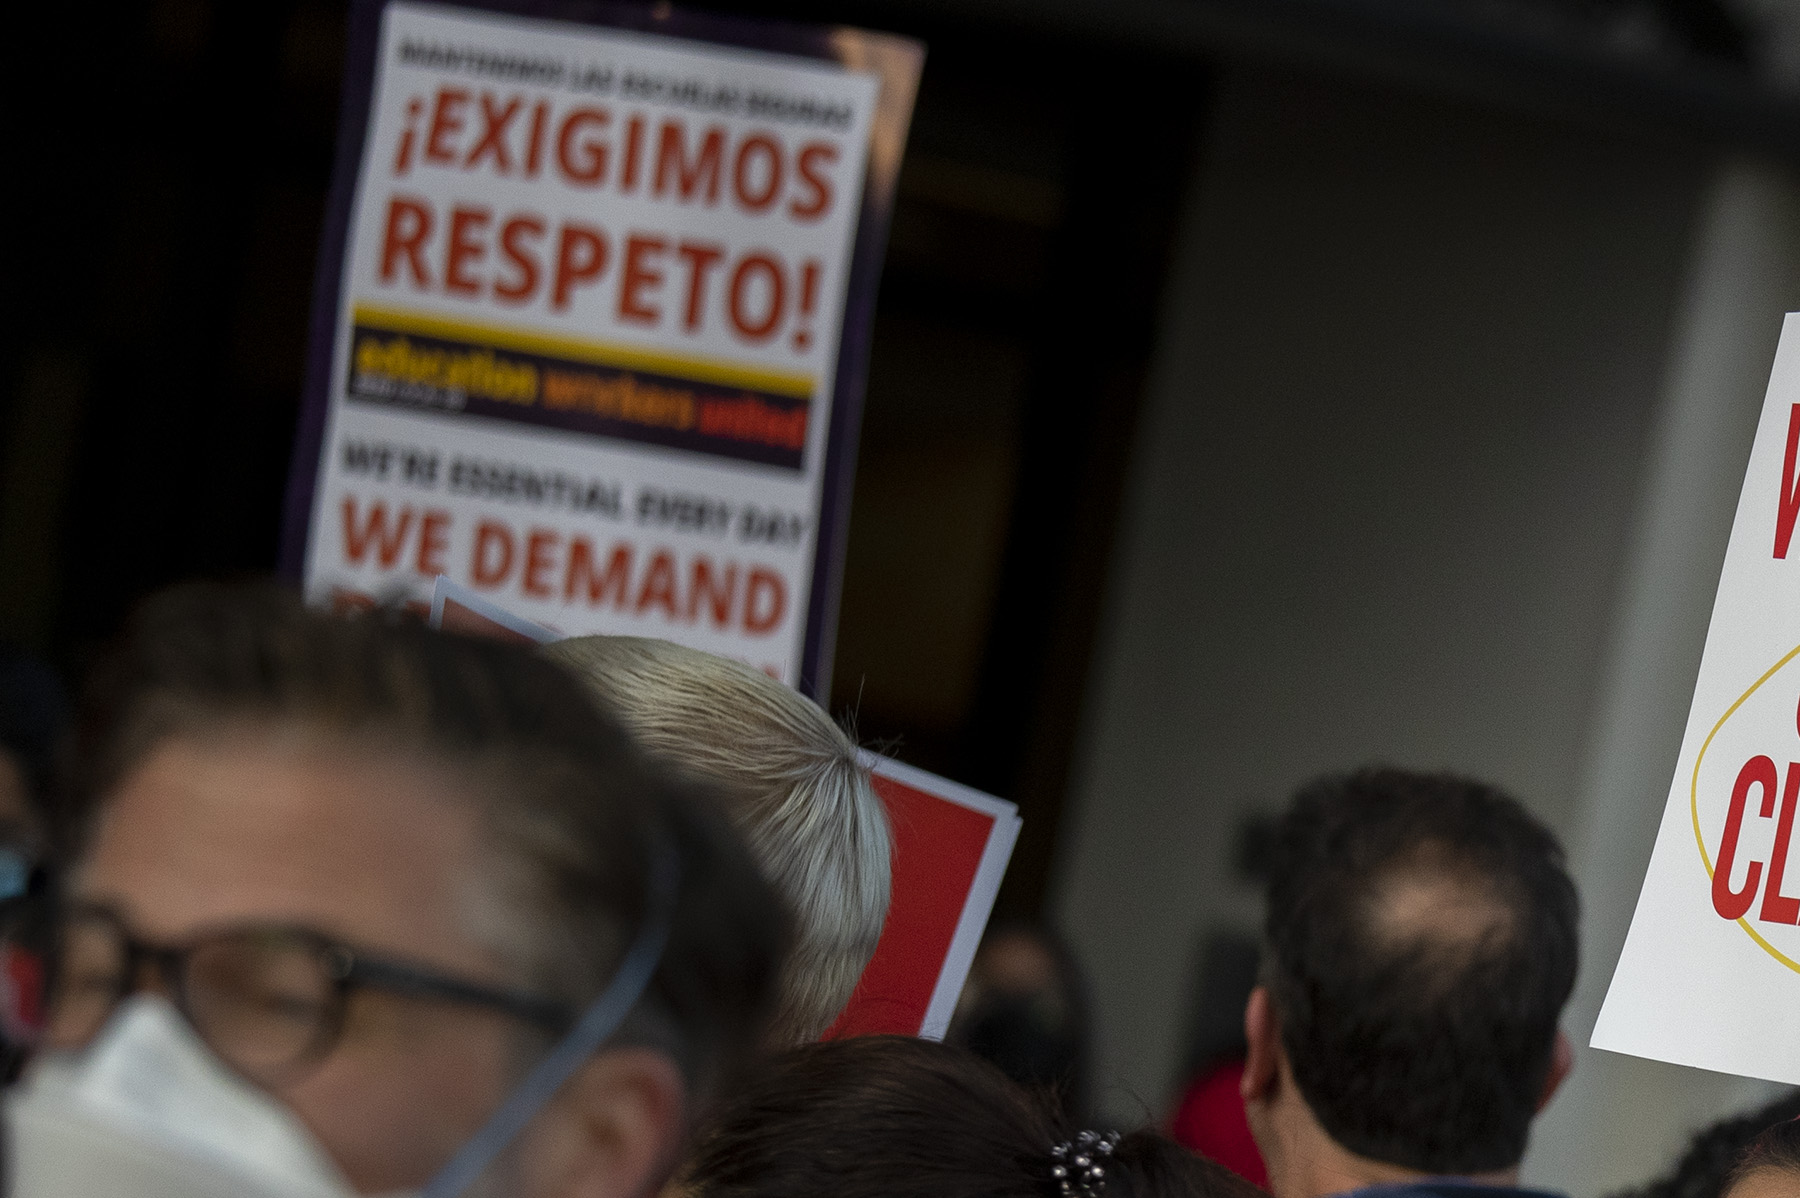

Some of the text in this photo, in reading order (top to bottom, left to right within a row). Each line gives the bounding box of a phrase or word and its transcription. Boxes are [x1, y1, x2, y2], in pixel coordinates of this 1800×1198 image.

[393, 86, 840, 221] ¡EXIGIMOS
[377, 196, 822, 353] RESPETO!
[356, 336, 538, 406] education
[340, 438, 807, 550] WE'RE ESSENTIAL EVERY DAY
[339, 494, 788, 637] WE DEMAND
